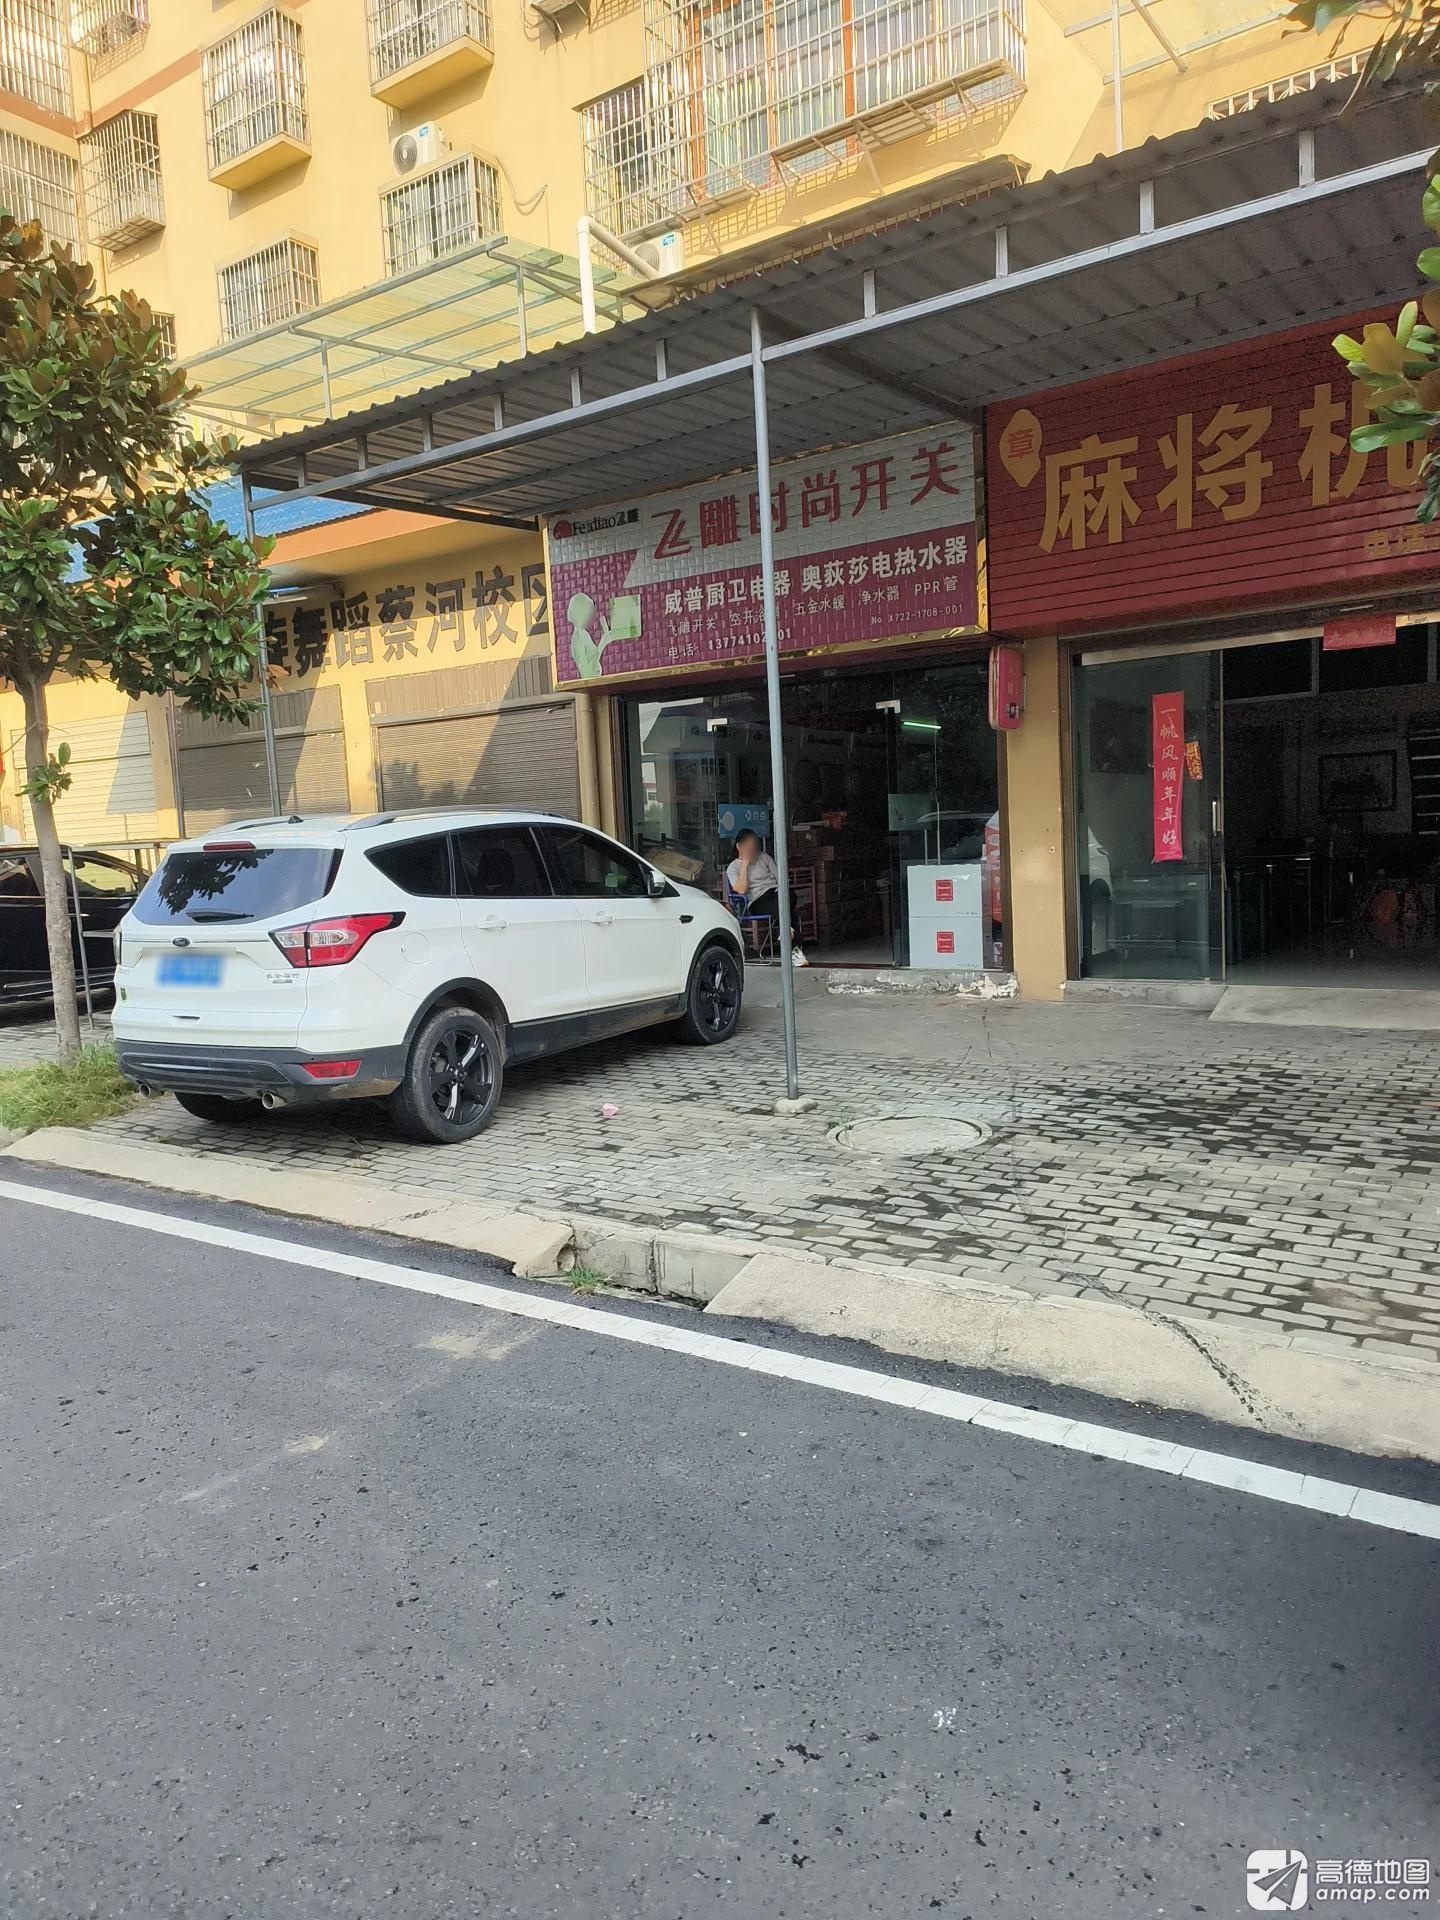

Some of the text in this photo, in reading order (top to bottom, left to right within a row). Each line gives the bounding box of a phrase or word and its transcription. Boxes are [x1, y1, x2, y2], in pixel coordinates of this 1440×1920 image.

[651, 442, 961, 560] 飞雕时尚开关
[664, 535, 968, 616] 威普厨卫电器 奥荻莎电热水器
[667, 616, 718, 638] 飞雕开关
[729, 603, 780, 627] 空开浴
[794, 594, 846, 616] 五金水暖
[858, 585, 901, 606] 净水器
[708, 628, 791, 651] 1377410201
